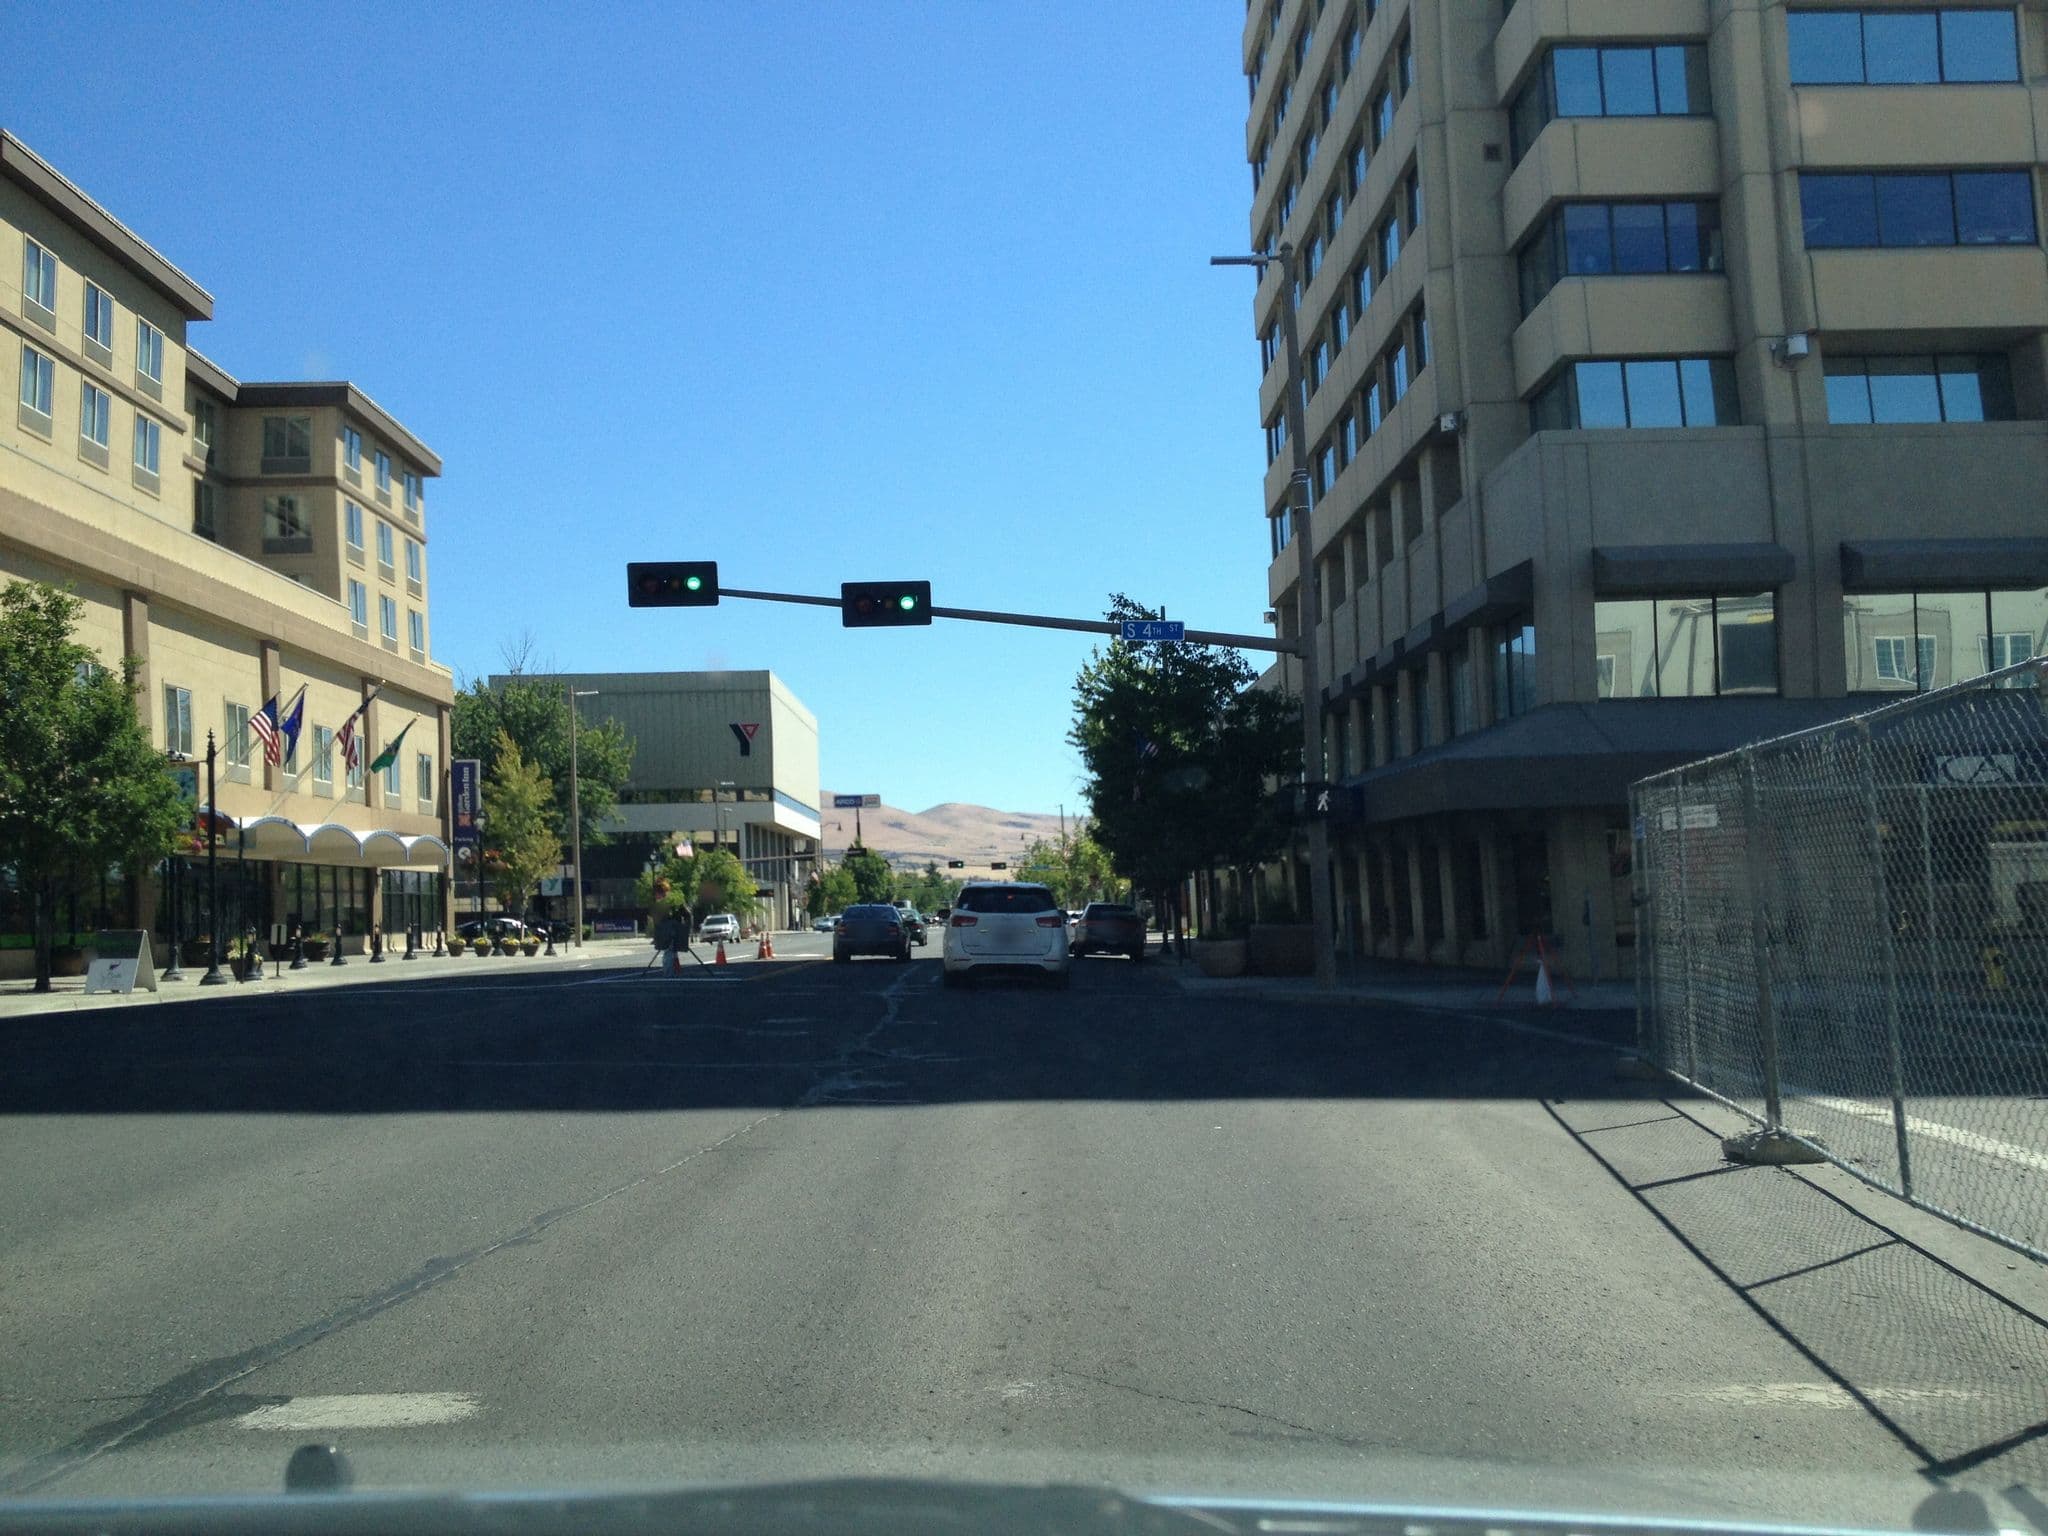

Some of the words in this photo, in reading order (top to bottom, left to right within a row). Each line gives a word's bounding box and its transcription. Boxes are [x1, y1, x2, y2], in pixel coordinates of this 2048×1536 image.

[1127, 623, 1135, 638] S
[1142, 623, 1162, 638] 4TH
[1169, 624, 1178, 632] ST
